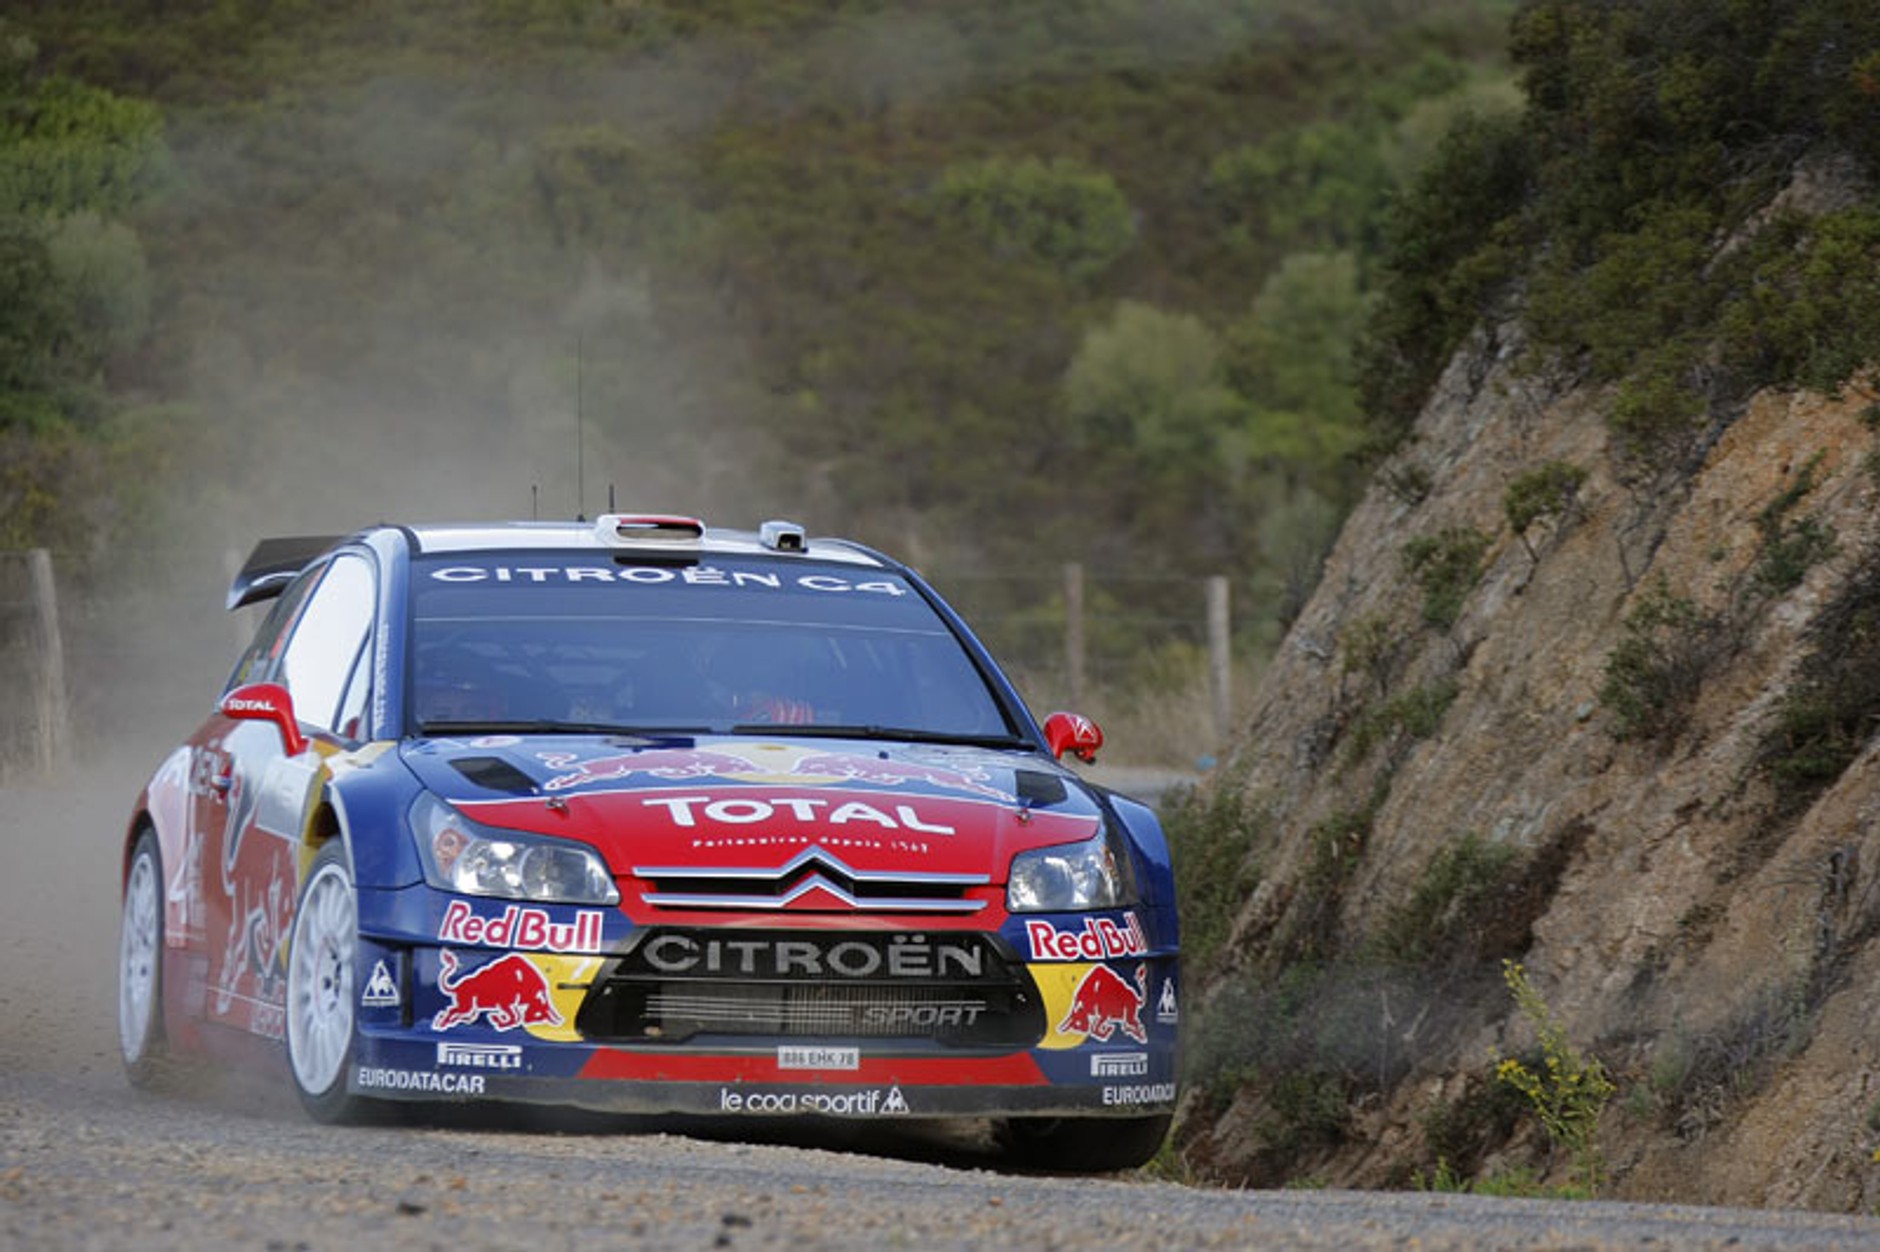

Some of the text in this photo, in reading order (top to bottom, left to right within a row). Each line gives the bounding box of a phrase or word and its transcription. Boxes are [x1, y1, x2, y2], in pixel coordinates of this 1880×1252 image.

[431, 566, 906, 597] CITROËN C4
[225, 699, 277, 711] TOTAL
[642, 797, 955, 834] TOTAL
[438, 900, 604, 953] Red Bull
[1025, 911, 1147, 960] Red Bull
[643, 934, 983, 977] CITROËN
[861, 1007, 987, 1026] SPORT
[437, 1043, 522, 1068] PIRELLI
[1090, 1053, 1148, 1076] PIRELLI
[358, 1067, 485, 1094] EURODATACAR
[721, 1087, 742, 1111] le
[801, 1089, 880, 1113] sportif
